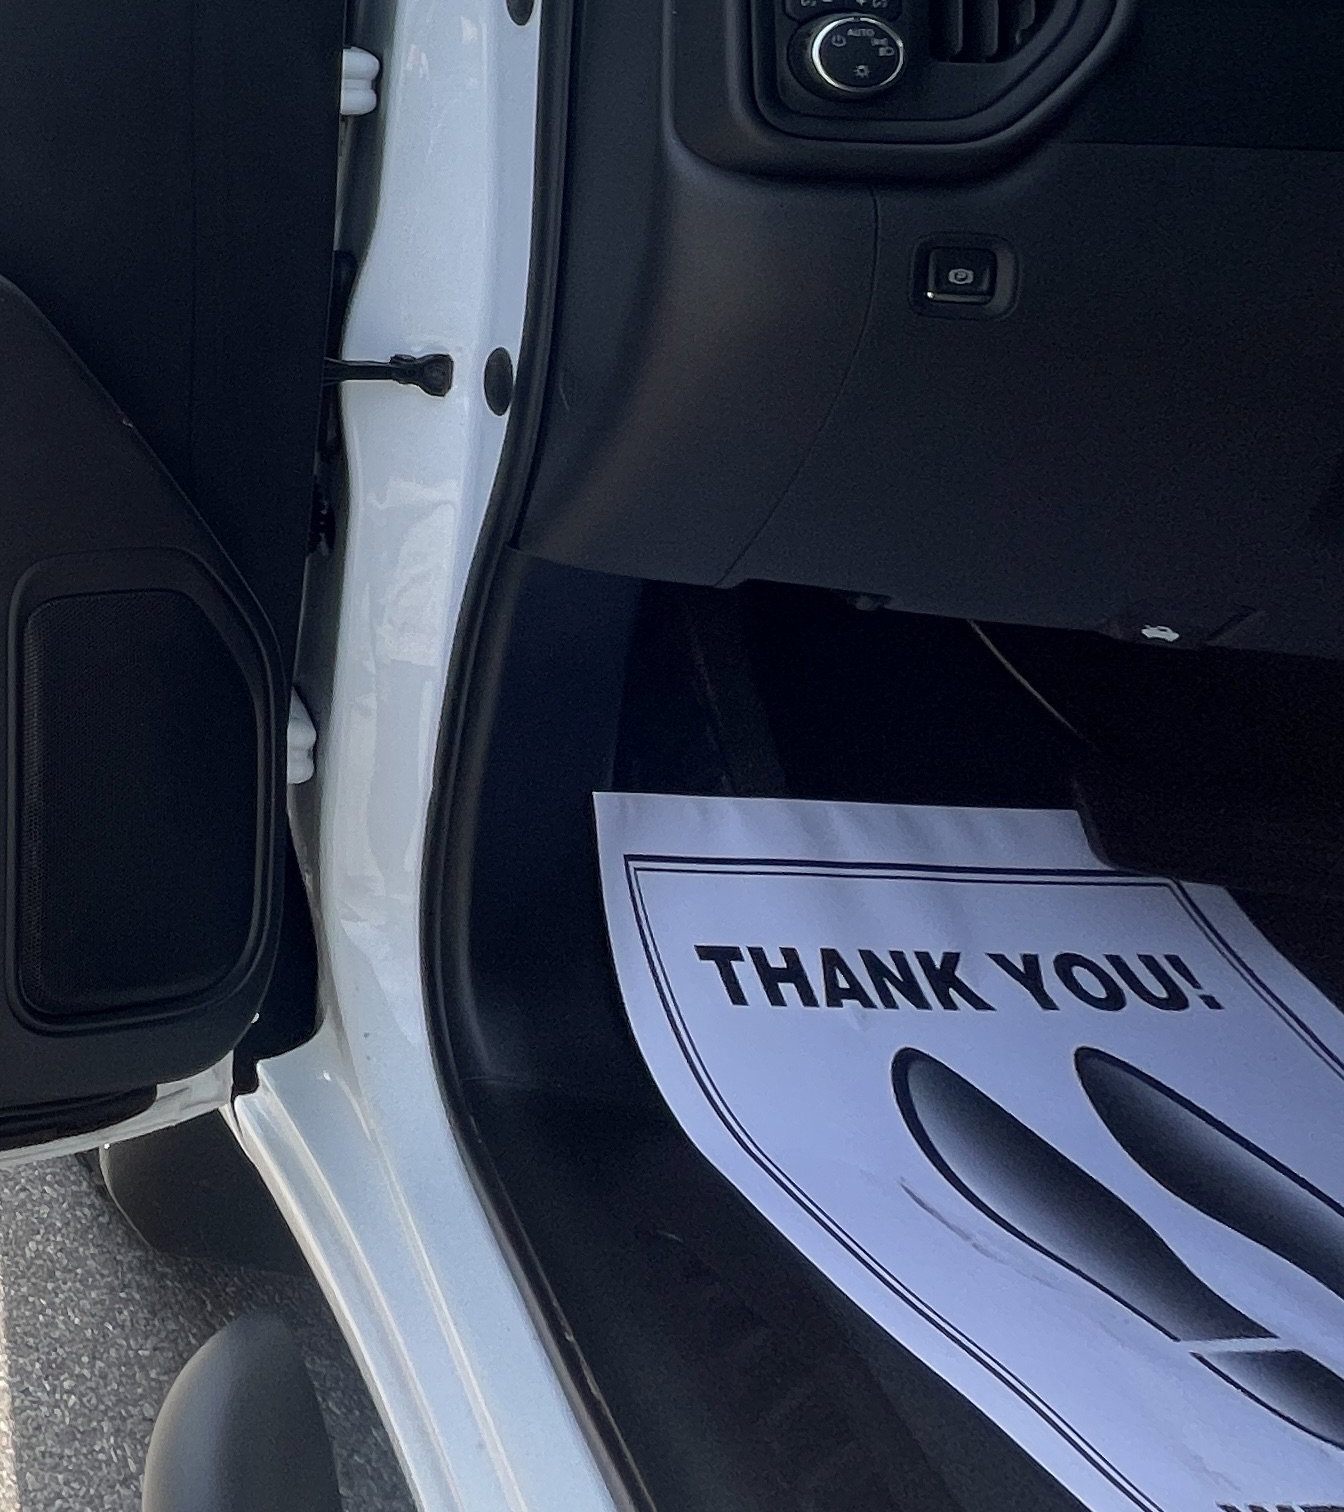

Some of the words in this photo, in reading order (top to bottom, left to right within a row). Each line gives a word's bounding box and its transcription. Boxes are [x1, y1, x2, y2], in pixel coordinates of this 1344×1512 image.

[847, 28, 875, 37] AUTO
[694, 944, 997, 1012] THANK
[985, 951, 1224, 1012] YOU!
